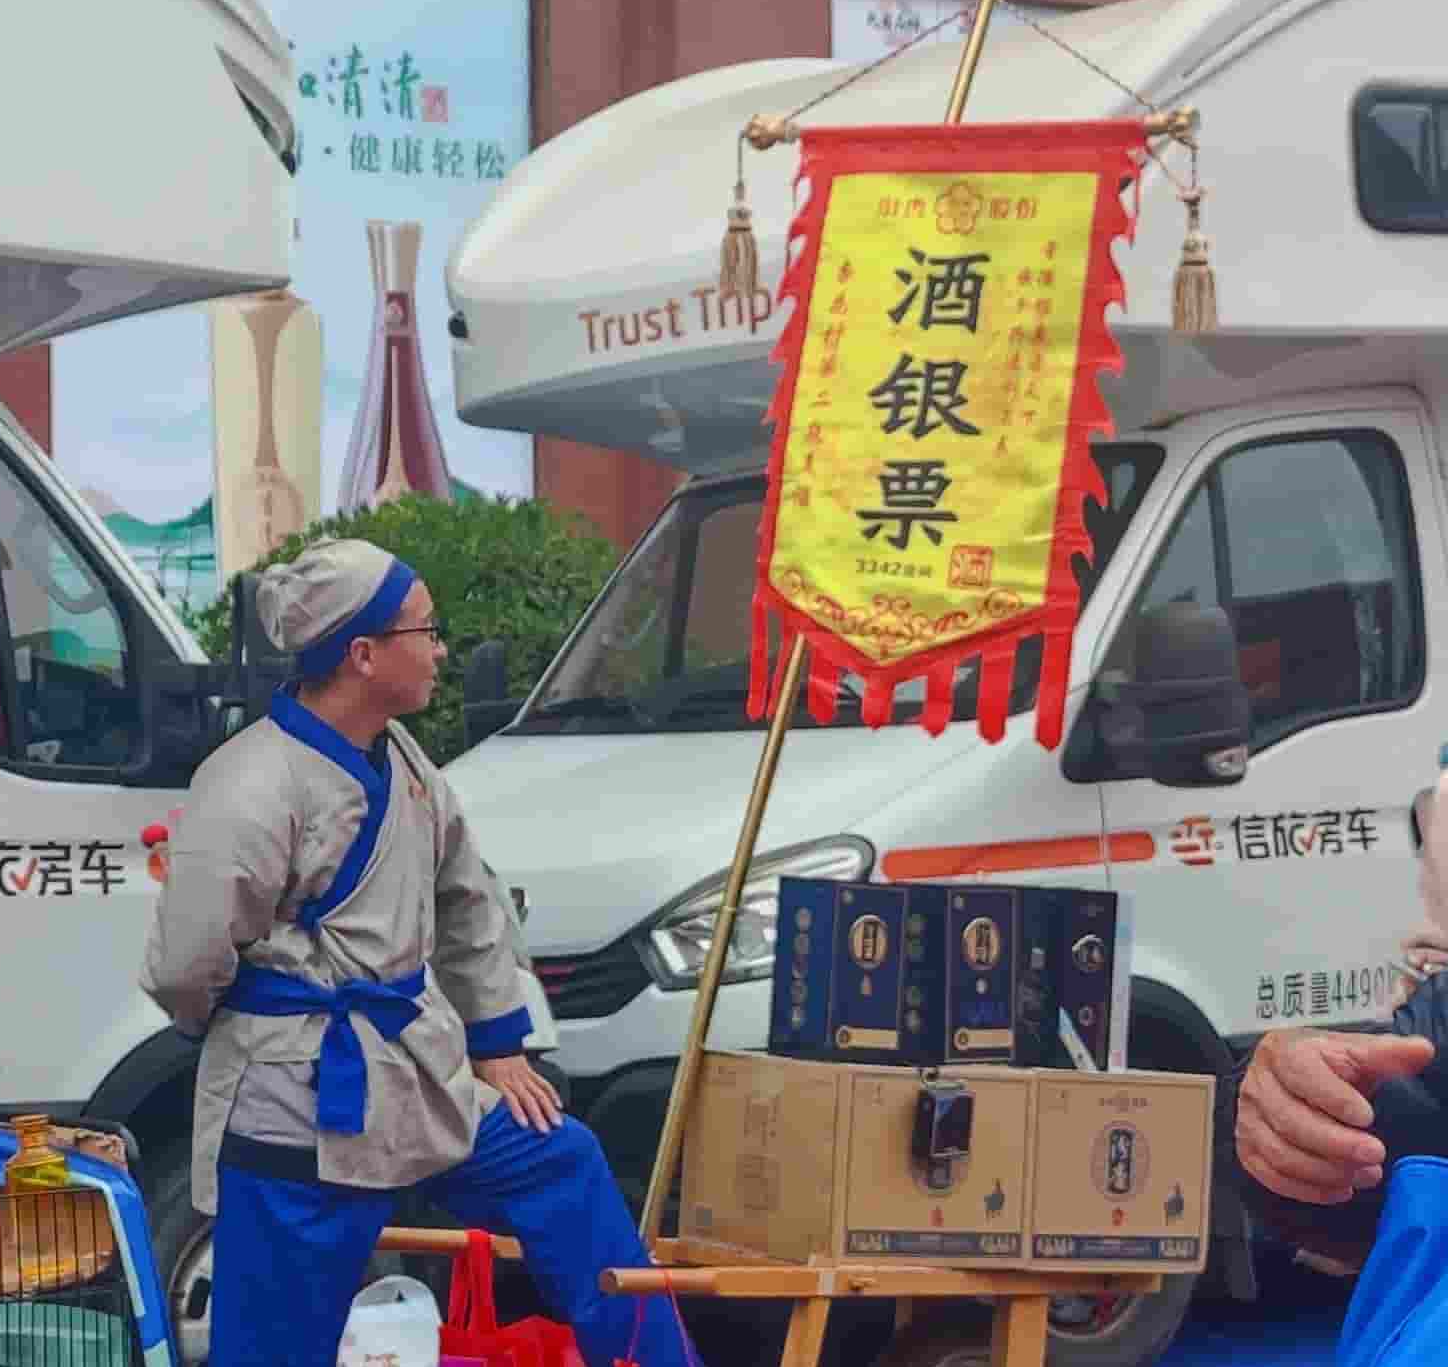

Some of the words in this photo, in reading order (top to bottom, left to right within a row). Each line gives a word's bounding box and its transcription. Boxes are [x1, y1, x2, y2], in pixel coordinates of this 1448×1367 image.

[577, 298, 688, 354] Trust
[855, 245, 992, 550] 酒银票
[1231, 806, 1381, 861] 信旅房车
